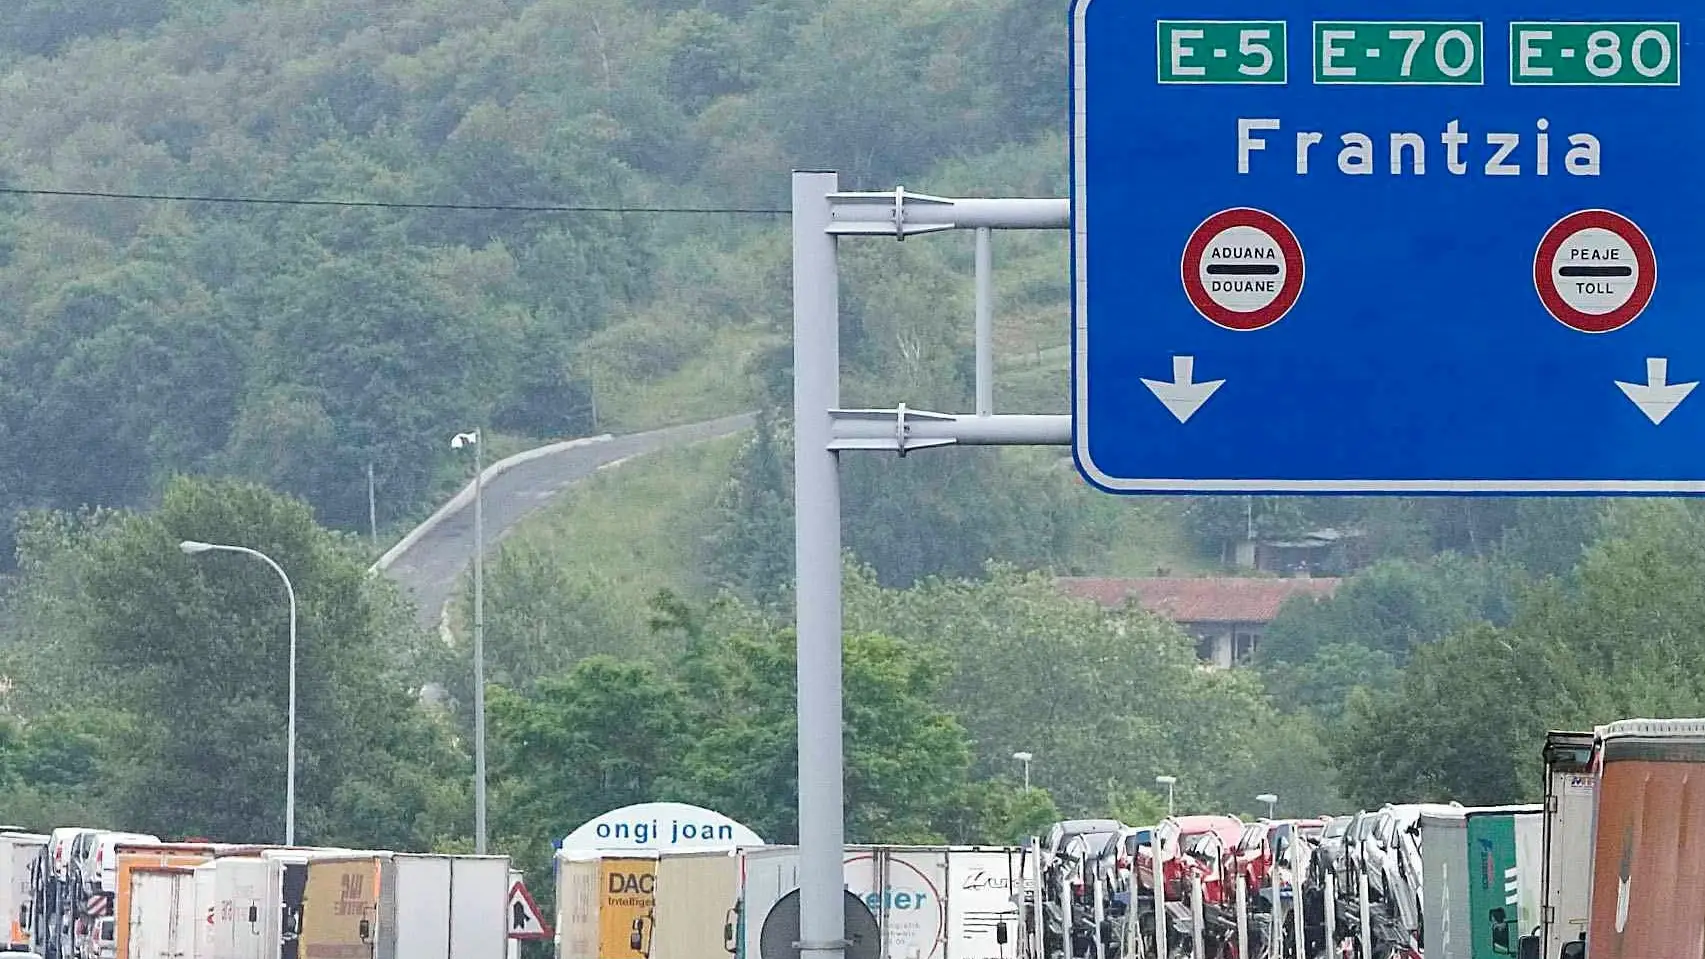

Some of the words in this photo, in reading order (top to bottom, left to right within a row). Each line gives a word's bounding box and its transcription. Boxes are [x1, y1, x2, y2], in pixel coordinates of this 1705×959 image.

[1169, 28, 1275, 77] E-5
[1322, 29, 1476, 78] E-70
[1518, 29, 1673, 78] E-80
[1236, 116, 1603, 177] Frantzia
[1211, 246, 1277, 261] ADUANA
[1569, 247, 1621, 262] PEAJE
[1211, 279, 1276, 293] DOUANE
[1575, 281, 1614, 295] TOLL
[596, 819, 658, 844] ongi
[671, 820, 733, 844] joan
